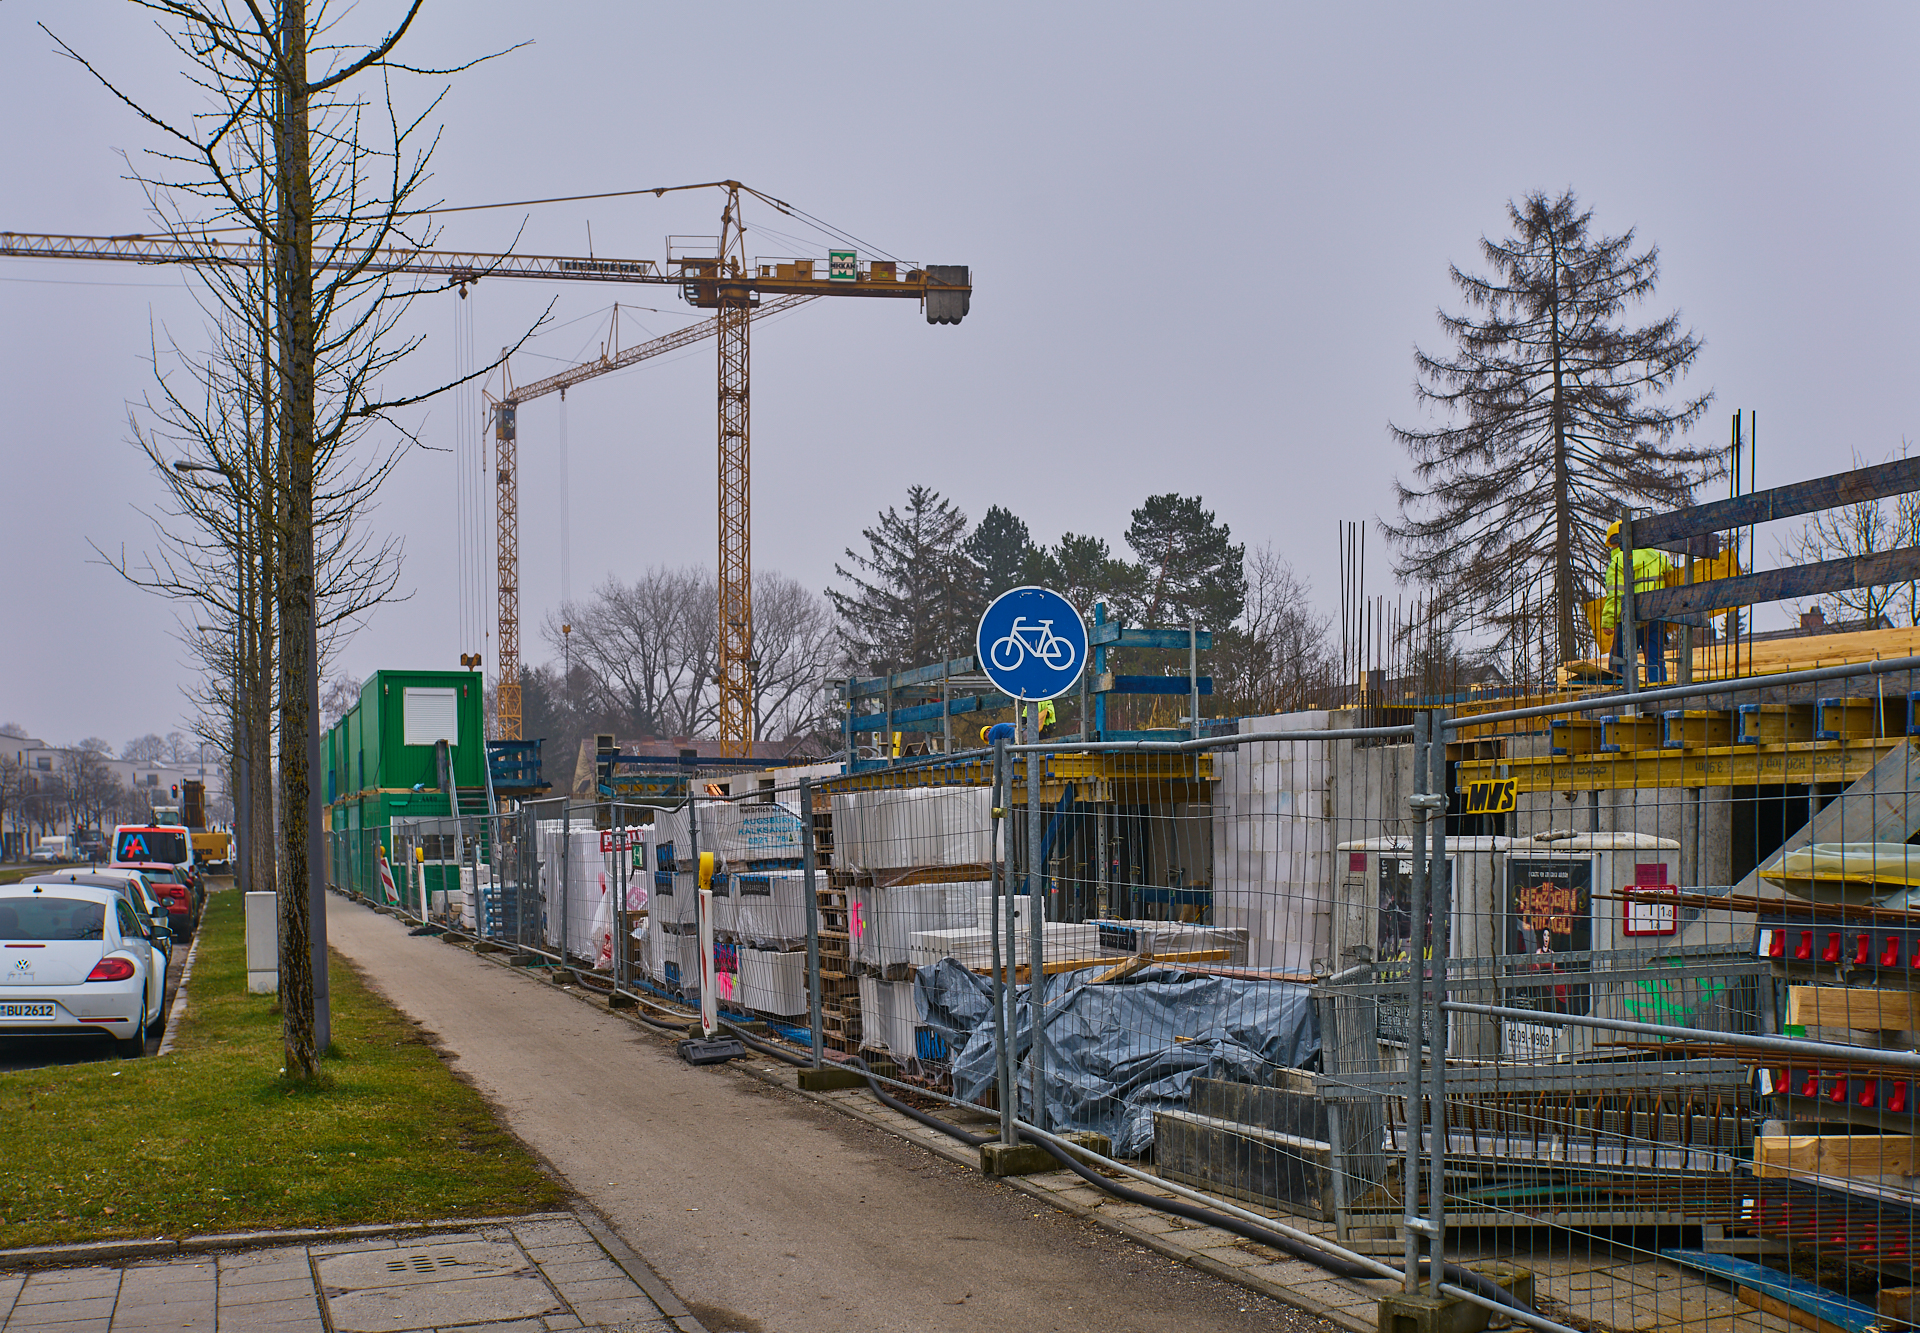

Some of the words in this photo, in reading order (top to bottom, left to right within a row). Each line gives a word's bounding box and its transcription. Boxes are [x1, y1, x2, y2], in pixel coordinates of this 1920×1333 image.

[565, 261, 641, 273] LIEBHERR
[1469, 781, 1515, 811] MVS
[1520, 888, 1577, 912] HERZOGIN
[7, 1005, 22, 1016] BU
[24, 1005, 53, 1016] 2612
